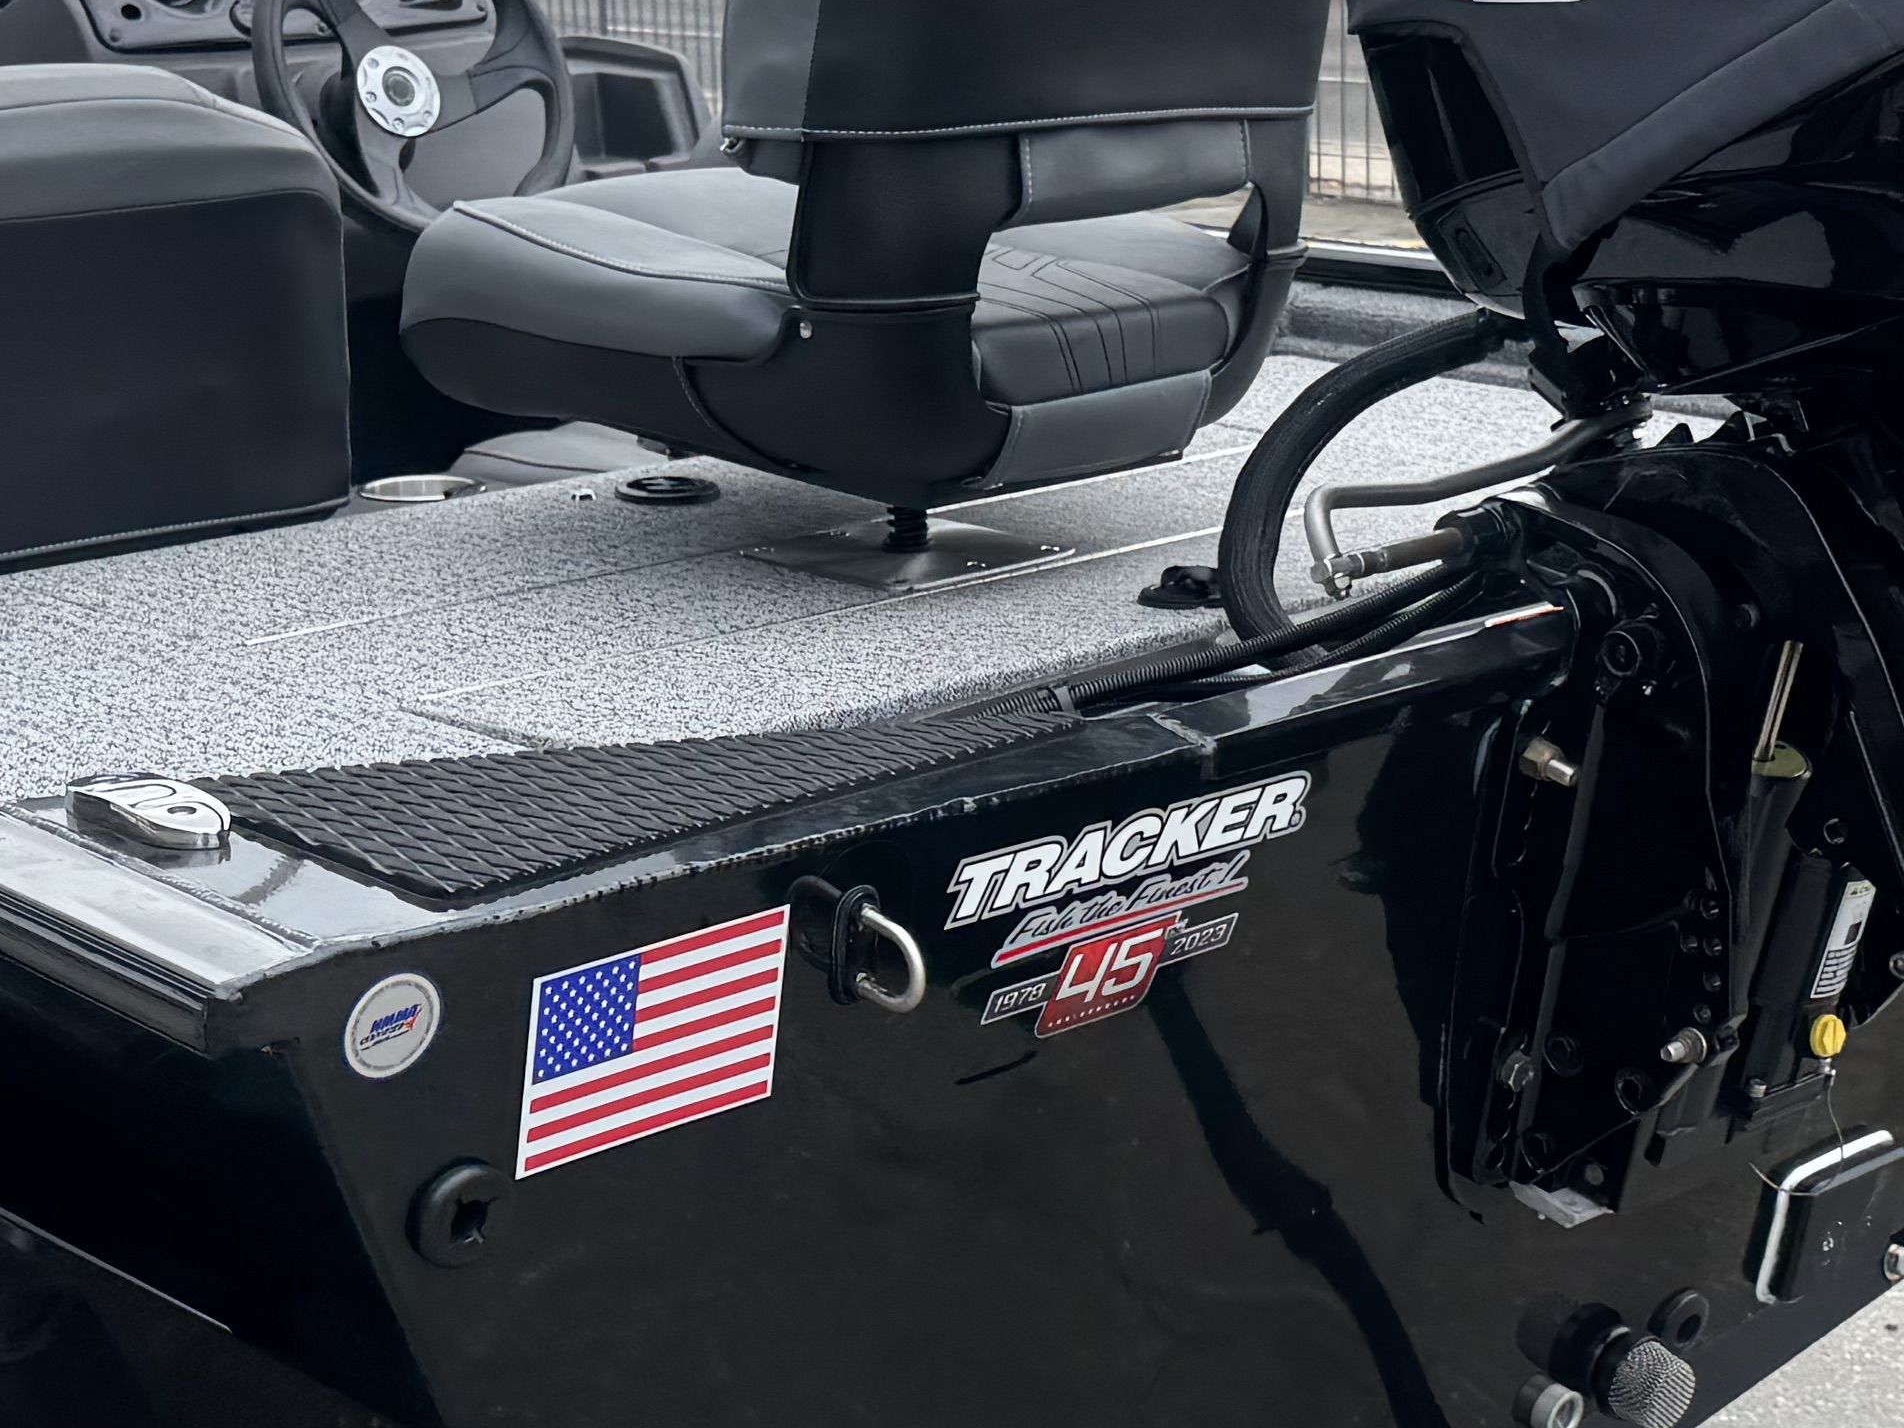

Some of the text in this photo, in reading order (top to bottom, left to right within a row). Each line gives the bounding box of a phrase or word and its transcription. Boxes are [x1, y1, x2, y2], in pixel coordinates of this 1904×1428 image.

[951, 774, 1308, 922] TRACKER
[1009, 903, 1074, 945] Fish
[1080, 894, 1124, 924] the
[993, 982, 1047, 1014] 1978
[1055, 928, 1164, 1004] 45
[1170, 923, 1228, 956] 2023
